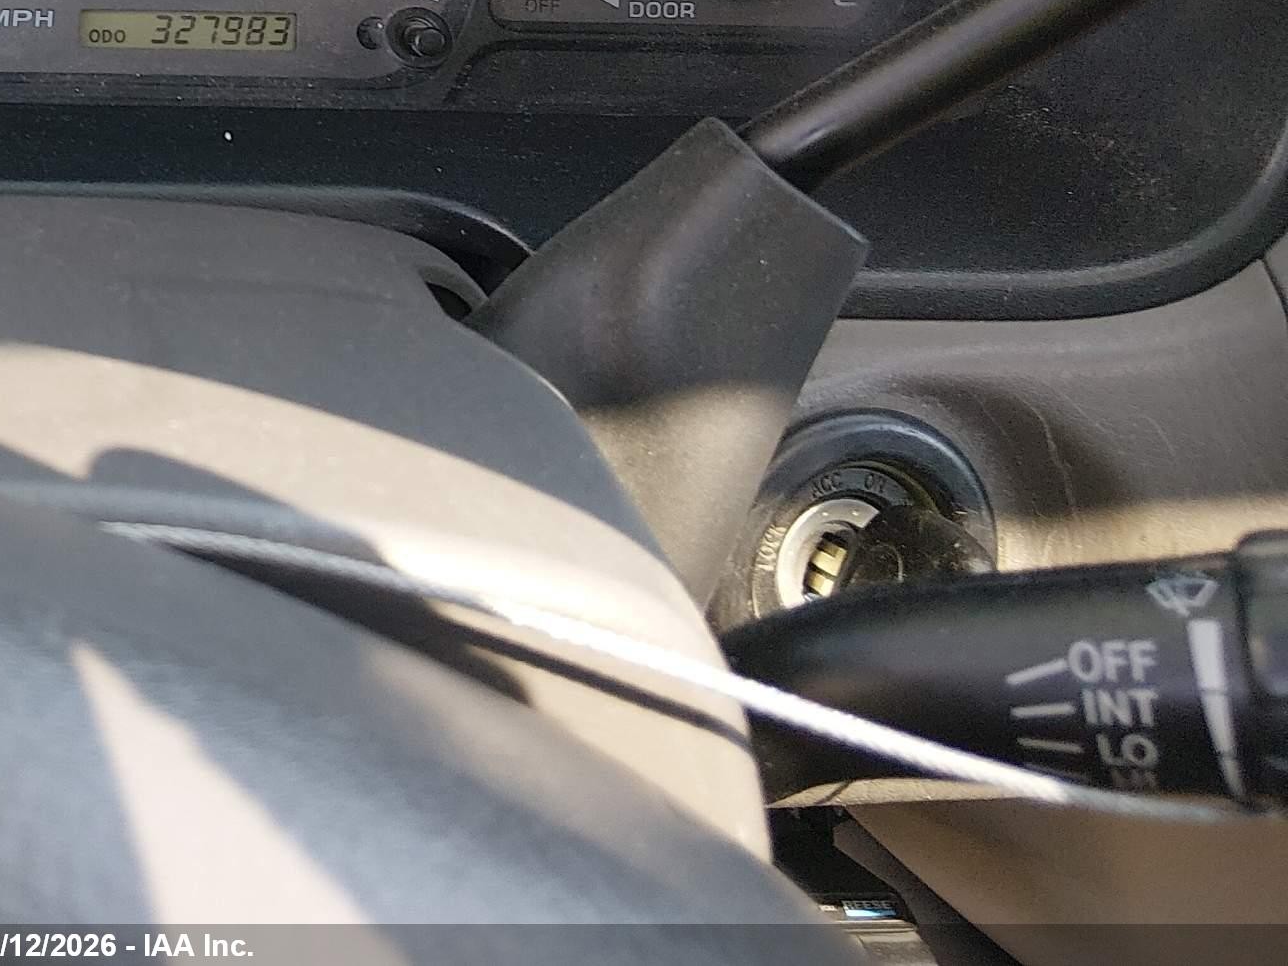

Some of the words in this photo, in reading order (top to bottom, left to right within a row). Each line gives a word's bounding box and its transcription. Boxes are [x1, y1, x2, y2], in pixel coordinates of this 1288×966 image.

[629, 1, 695, 19] DOOR
[88, 28, 126, 44] ODO
[150, 14, 291, 45] 327983
[1067, 640, 1157, 682] OFF
[1082, 689, 1158, 726] INT
[1097, 734, 1158, 767] LO
